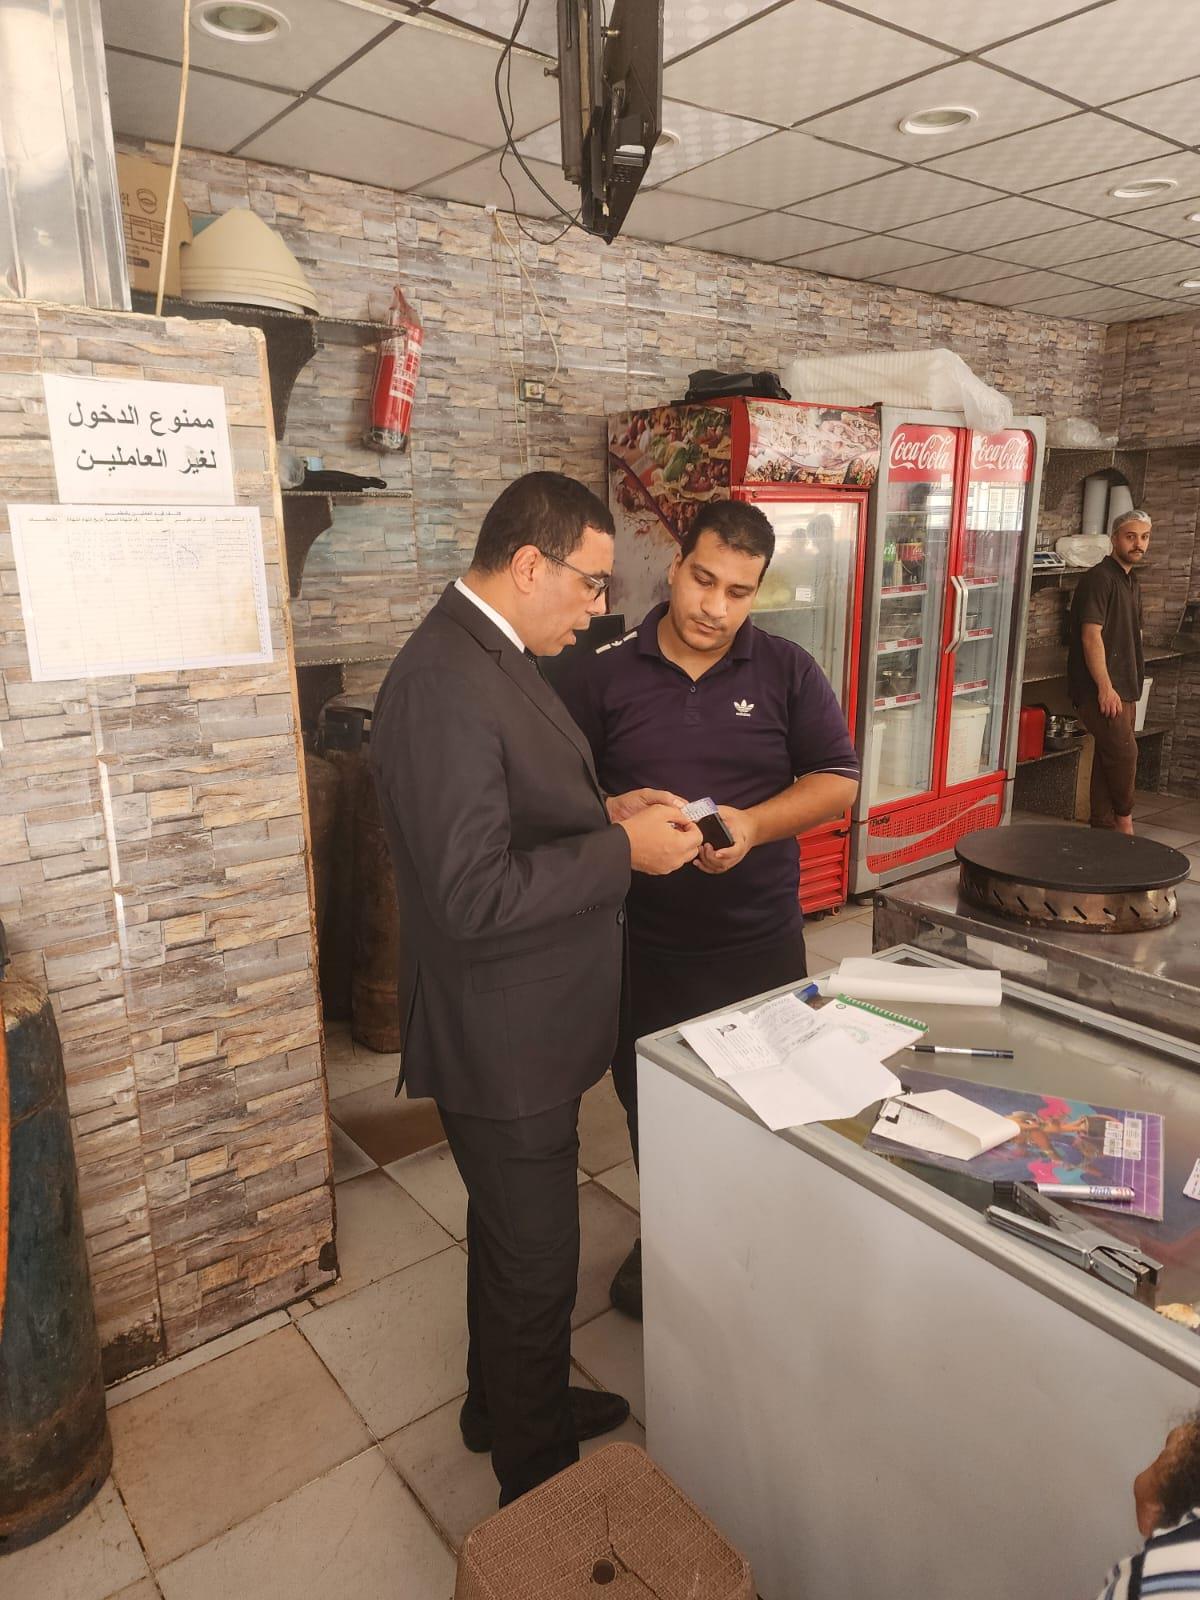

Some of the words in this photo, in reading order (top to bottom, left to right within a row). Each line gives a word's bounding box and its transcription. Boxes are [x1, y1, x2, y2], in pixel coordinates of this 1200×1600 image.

[68, 400, 139, 429] الدخول
[149, 408, 215, 437] ممنوع
[76, 445, 168, 472] العاملين
[178, 449, 217, 475] لغير
[890, 432, 953, 470] Coca-Cola
